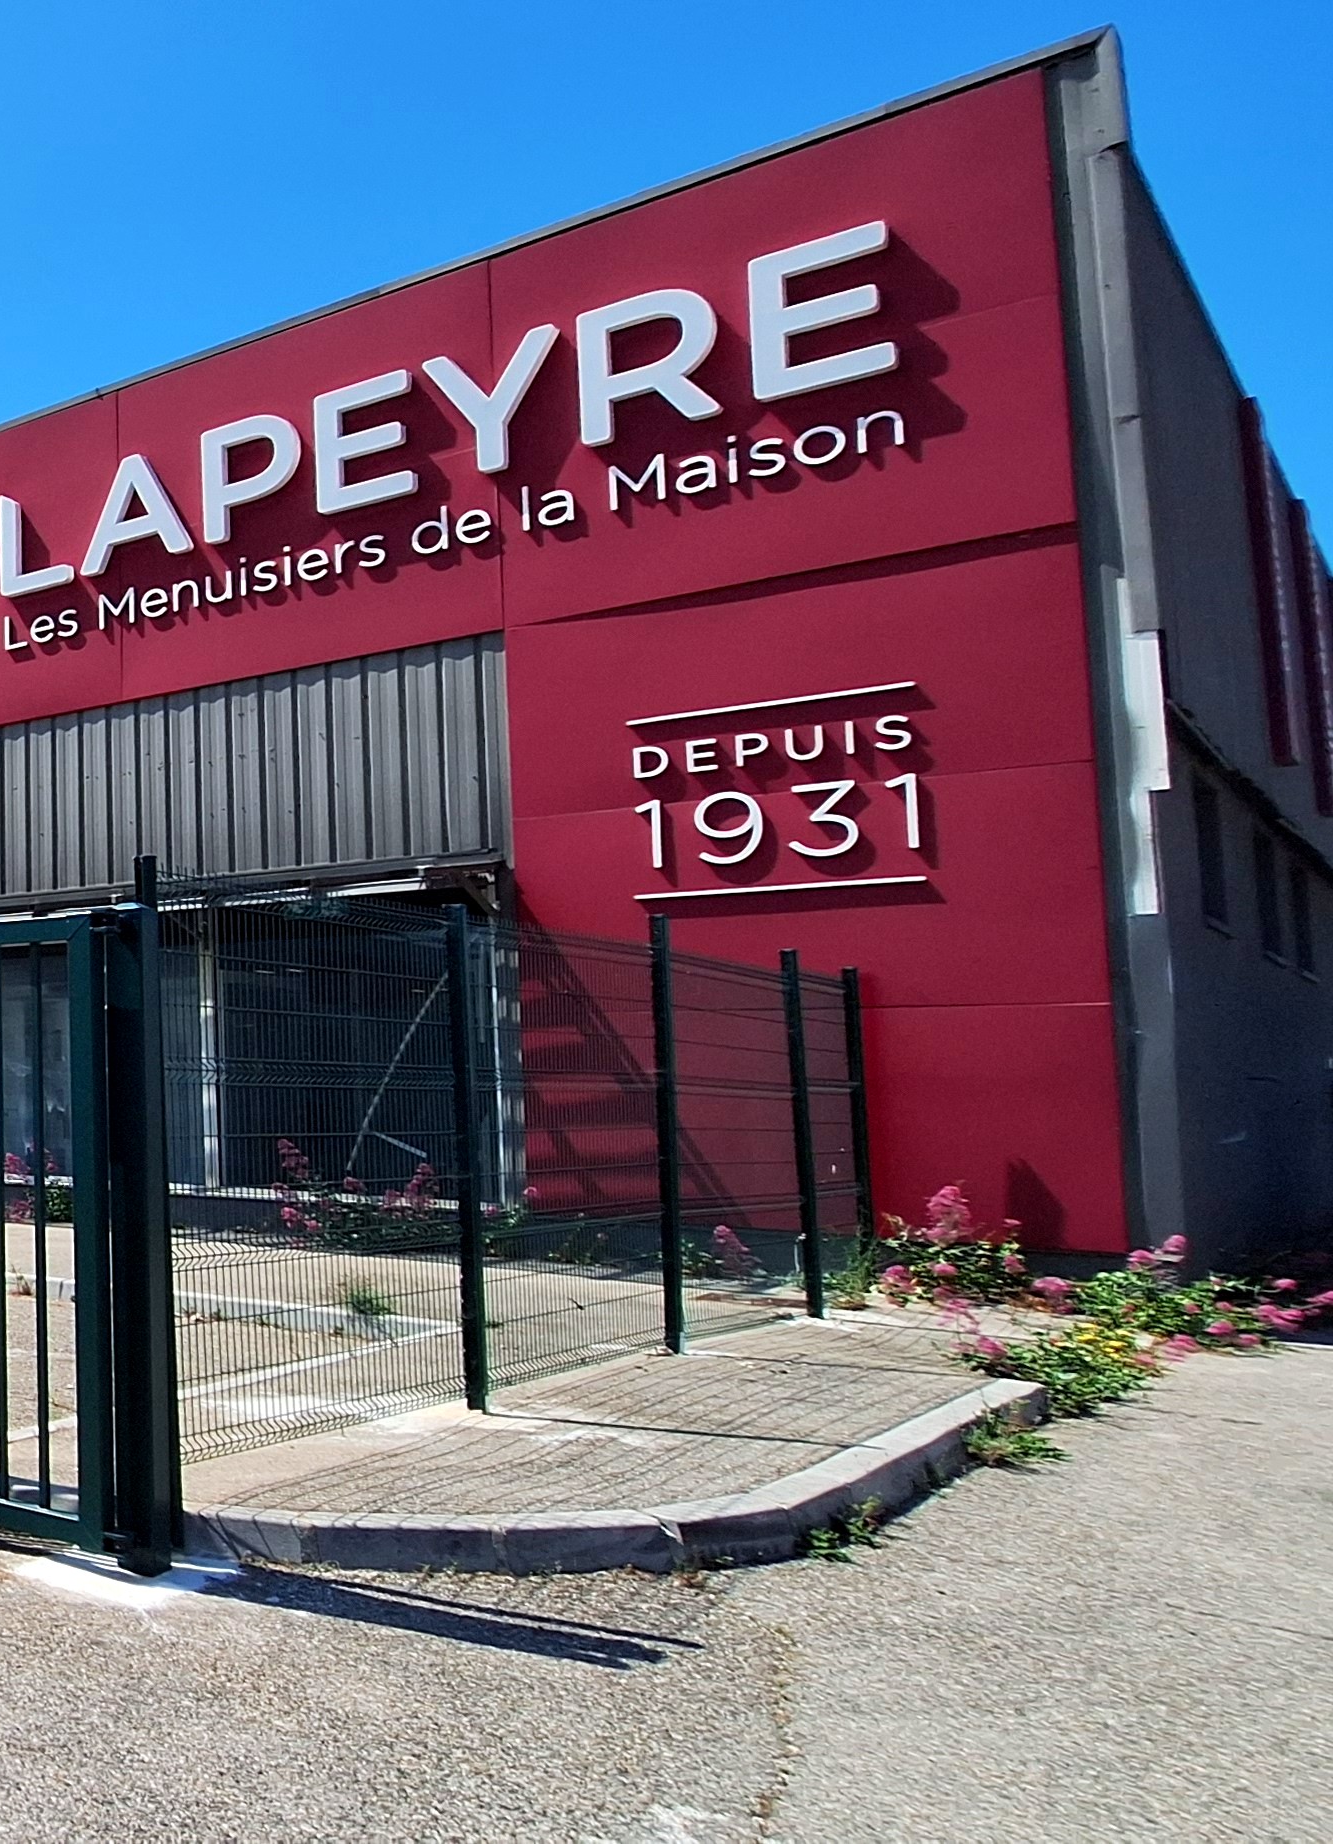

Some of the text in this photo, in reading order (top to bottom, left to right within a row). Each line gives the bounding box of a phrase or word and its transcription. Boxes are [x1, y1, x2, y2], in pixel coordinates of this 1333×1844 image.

[1, 408, 906, 652] Les Menuisiers de la Maison
[632, 713, 914, 782] DEPUIS
[634, 771, 924, 871] 1931
